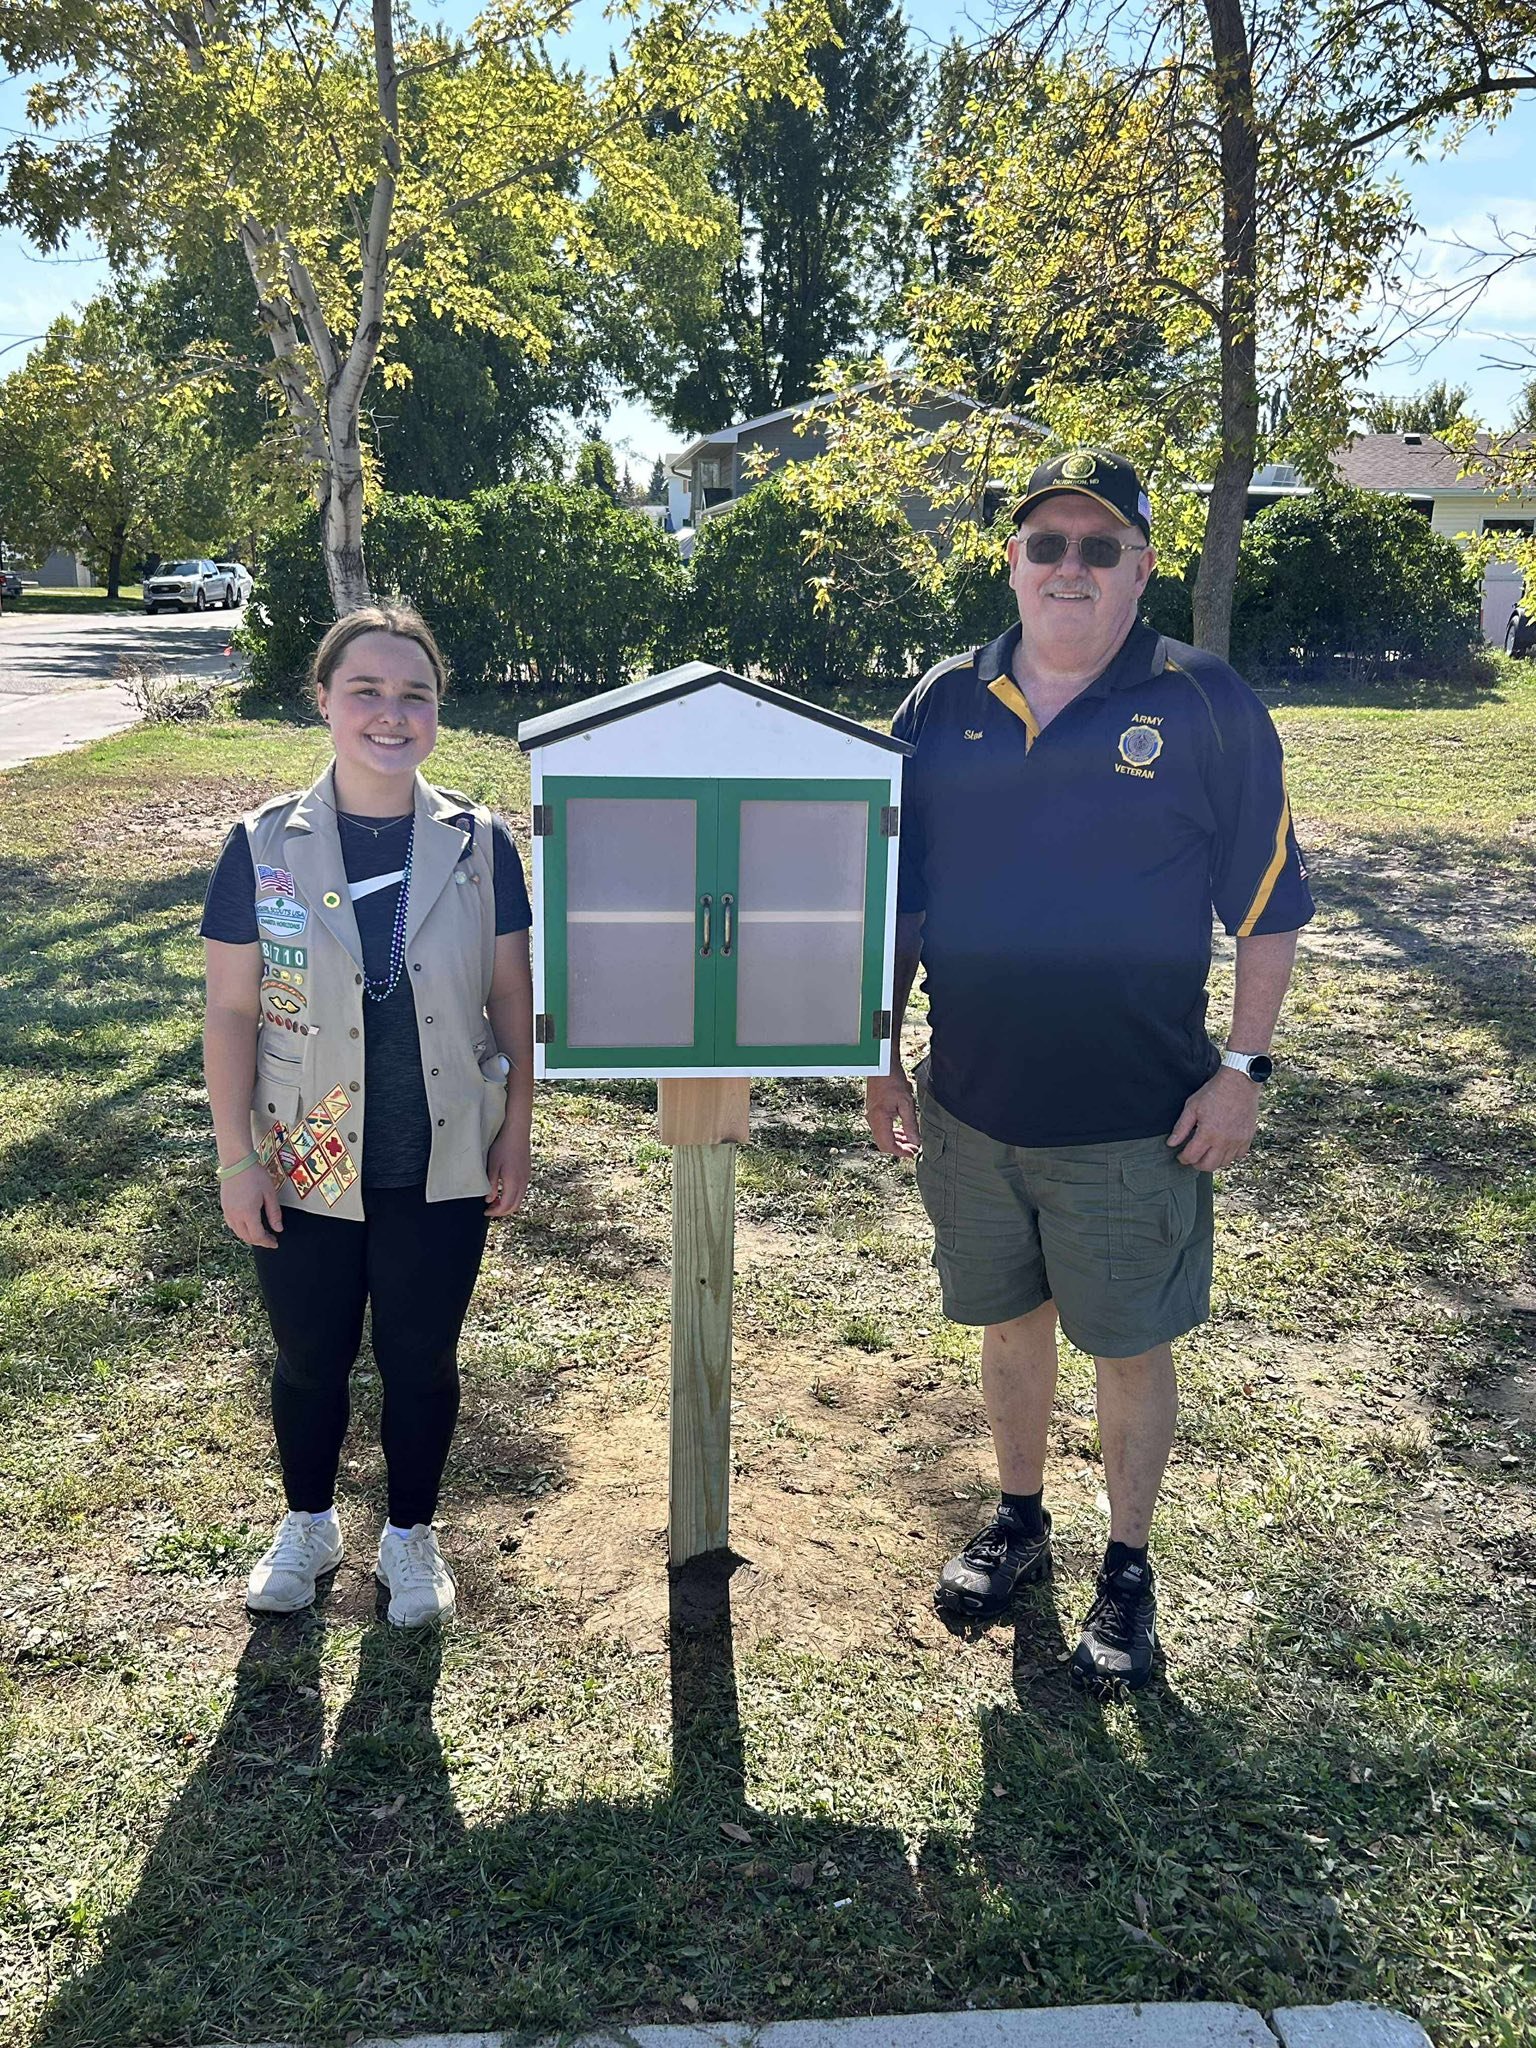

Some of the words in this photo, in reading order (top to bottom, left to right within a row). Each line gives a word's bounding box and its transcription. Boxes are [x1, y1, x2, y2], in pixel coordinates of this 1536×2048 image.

[1131, 713, 1164, 726] ARMY
[1114, 763, 1155, 779] VETERAN
[270, 907, 292, 916] SCOUTS
[1127, 1564, 1144, 1576] NIKE
